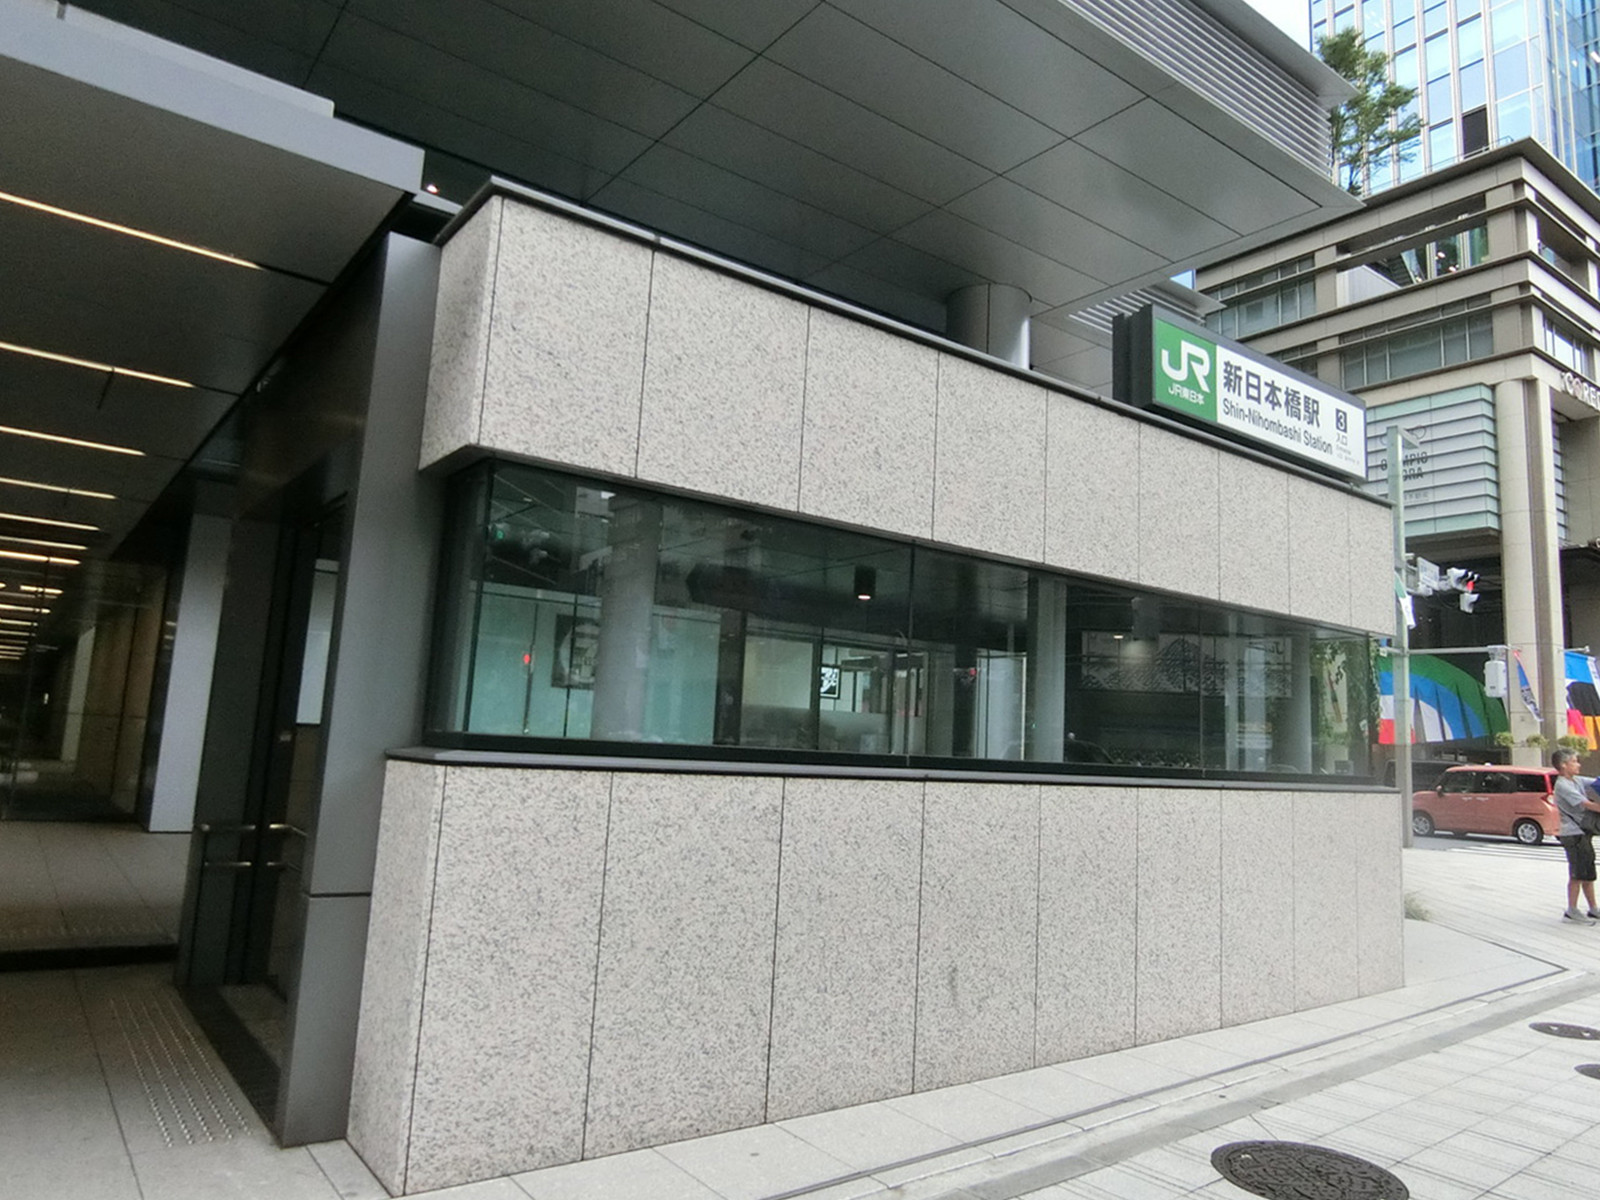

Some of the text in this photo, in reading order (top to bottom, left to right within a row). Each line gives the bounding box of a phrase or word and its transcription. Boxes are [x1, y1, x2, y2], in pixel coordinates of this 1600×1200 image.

[1161, 340, 1211, 393] JR
[1168, 383, 1205, 405] JR東日本
[1223, 360, 1321, 429] 新日本橋駅
[1223, 397, 1333, 455] Shin-Nihombashi Station
[1337, 410, 1346, 432] 3
